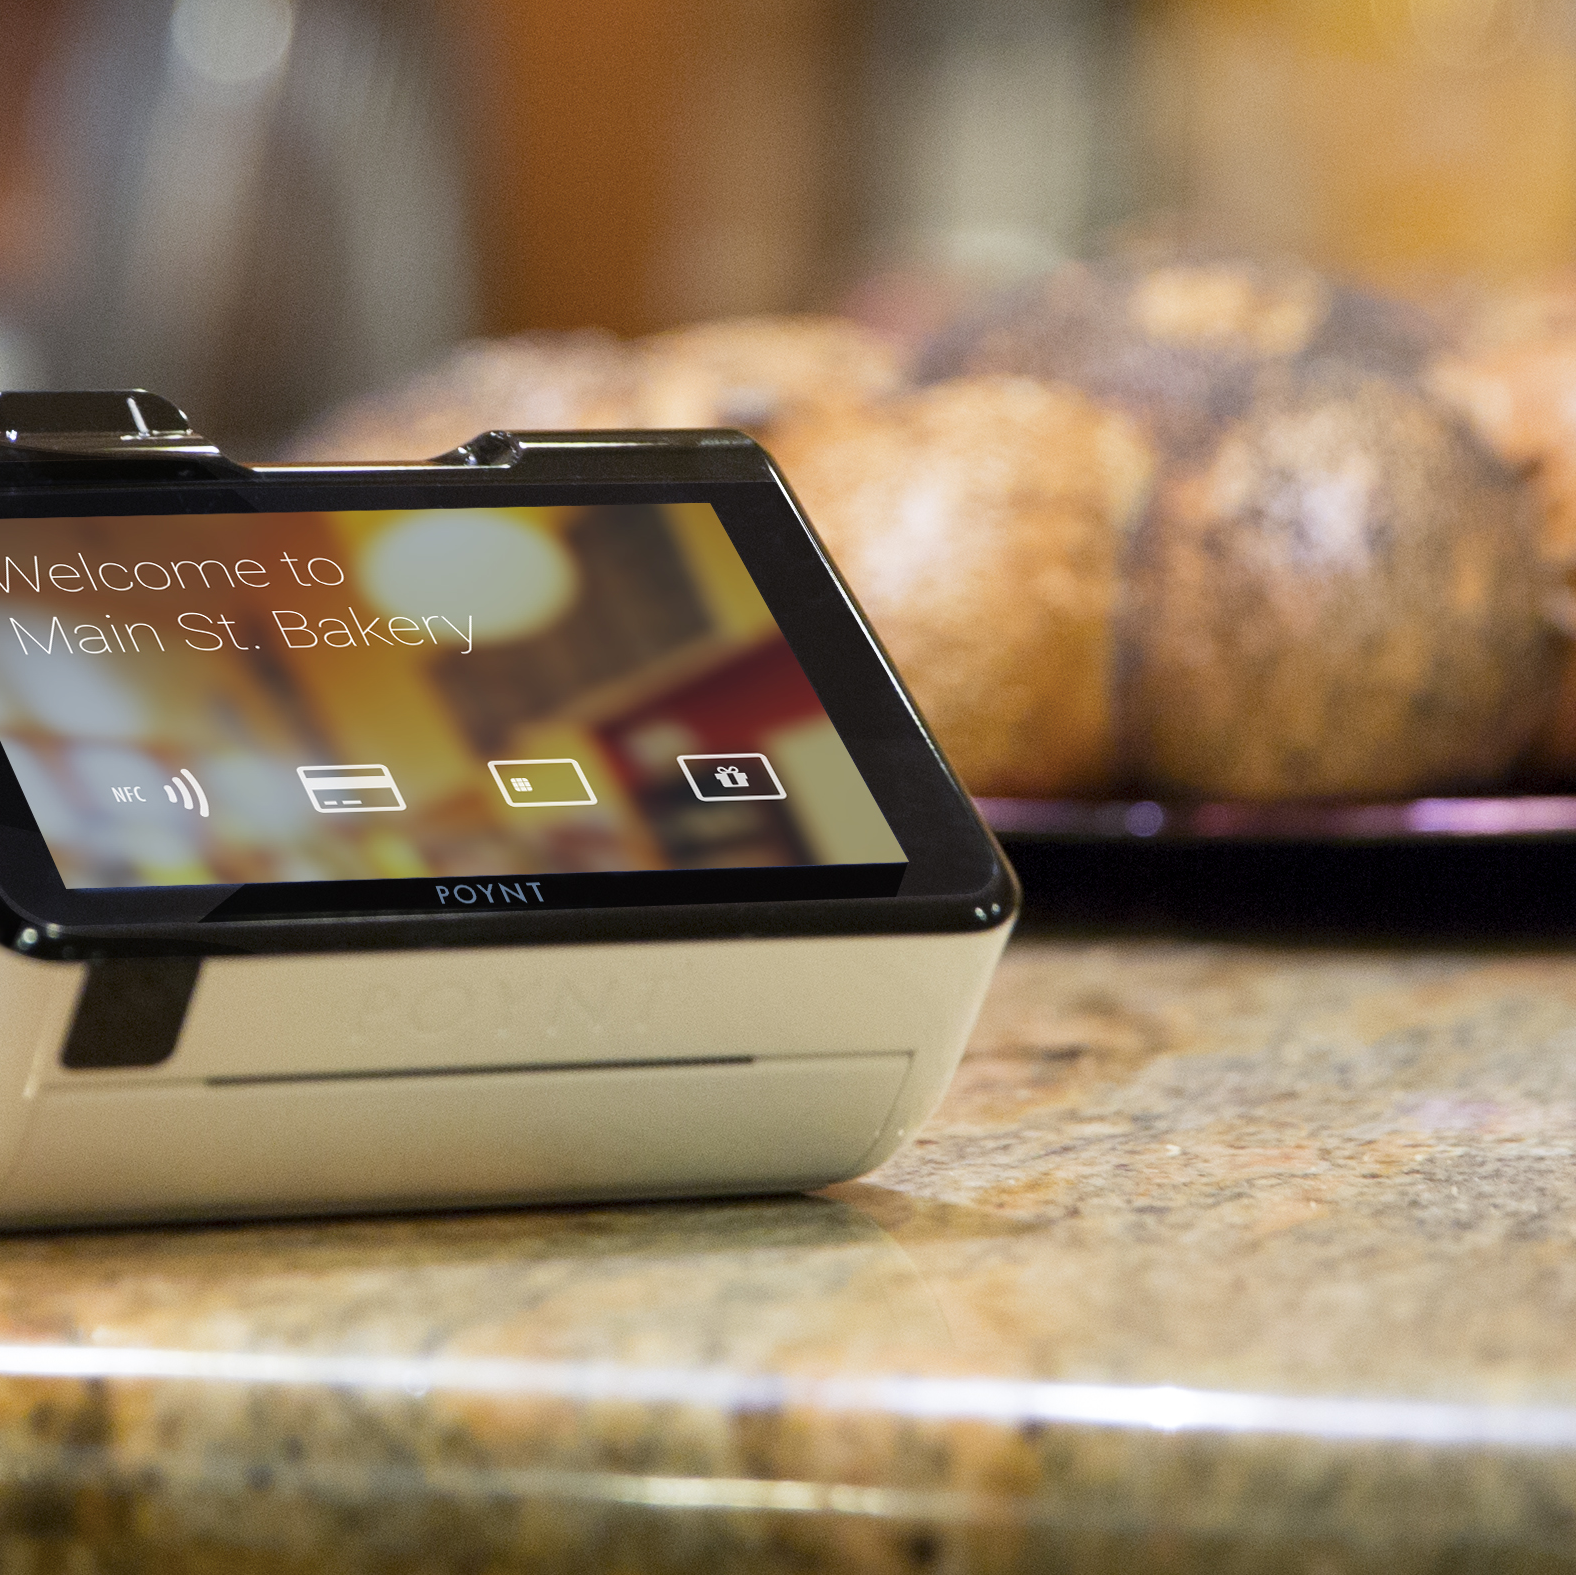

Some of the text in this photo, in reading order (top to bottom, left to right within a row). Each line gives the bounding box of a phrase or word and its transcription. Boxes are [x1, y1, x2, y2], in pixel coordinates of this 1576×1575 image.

[279, 551, 346, 588] to
[8, 605, 474, 657] Main St. Bakery
[110, 785, 148, 803] NFC
[434, 881, 545, 905] POYNT
[347, 970, 677, 1043] POYNT
